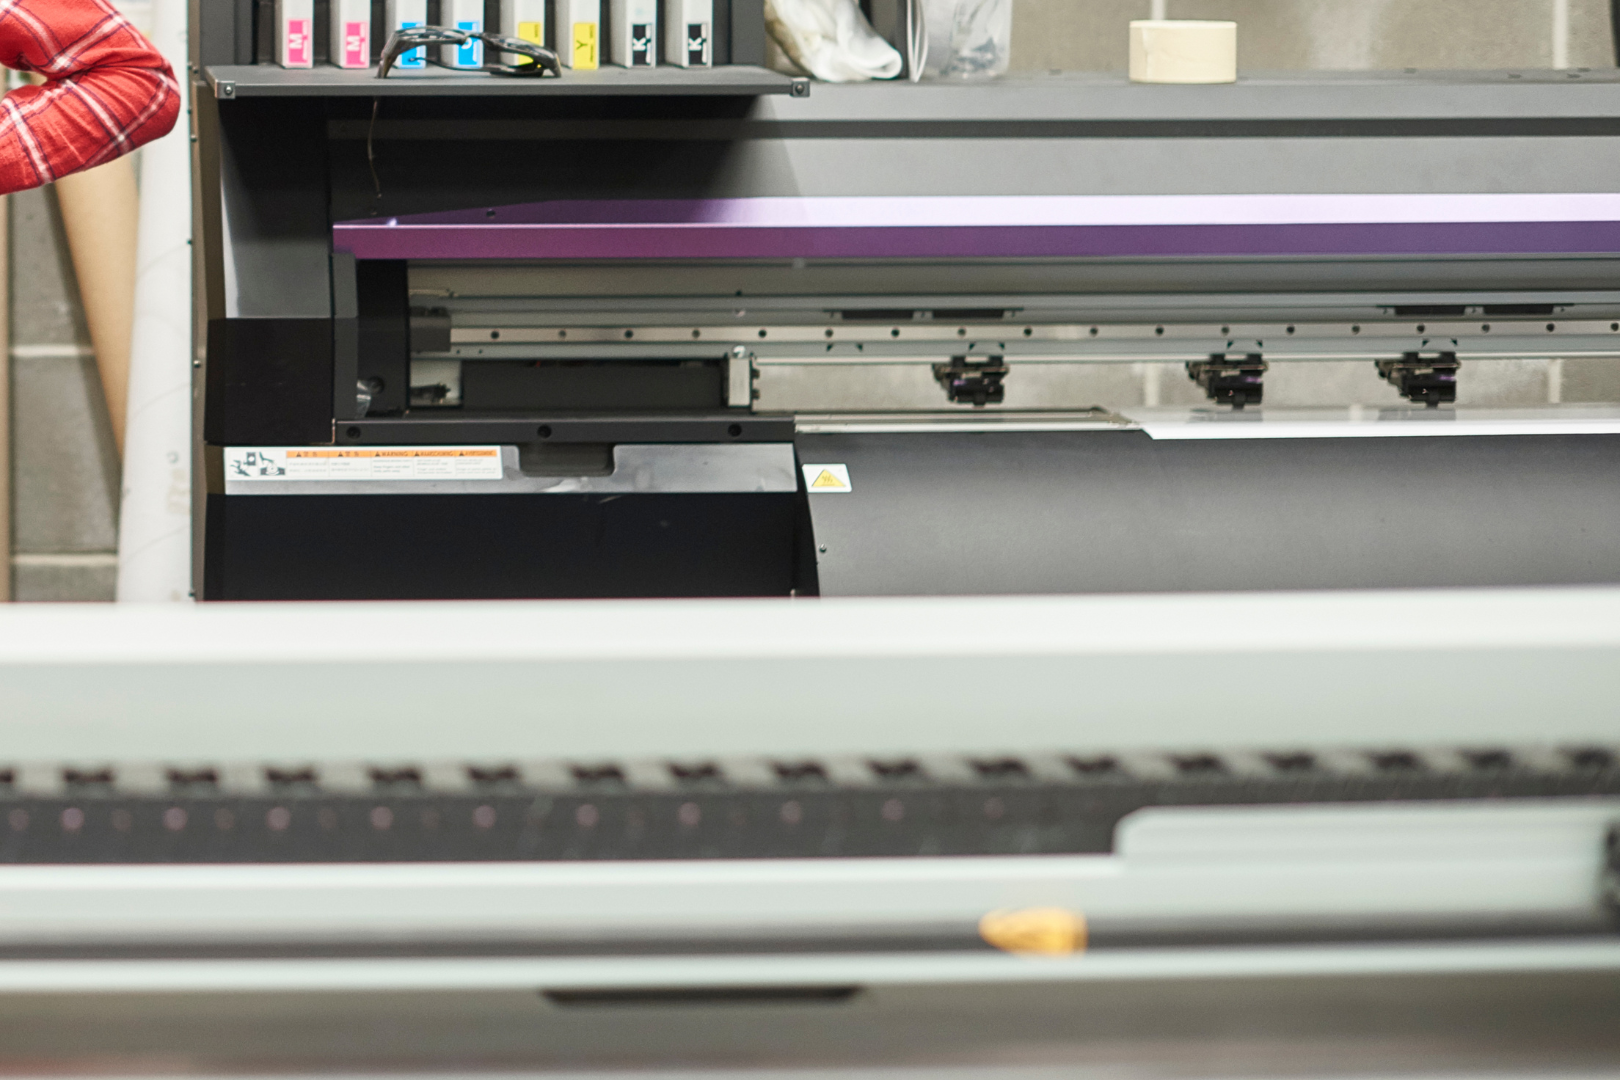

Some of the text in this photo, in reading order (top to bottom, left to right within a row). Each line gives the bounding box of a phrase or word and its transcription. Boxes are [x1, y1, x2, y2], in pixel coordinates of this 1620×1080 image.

[289, 33, 303, 49] M
[346, 35, 360, 51] M
[576, 39, 588, 50] Y
[633, 37, 647, 51] K
[688, 37, 702, 51] K
